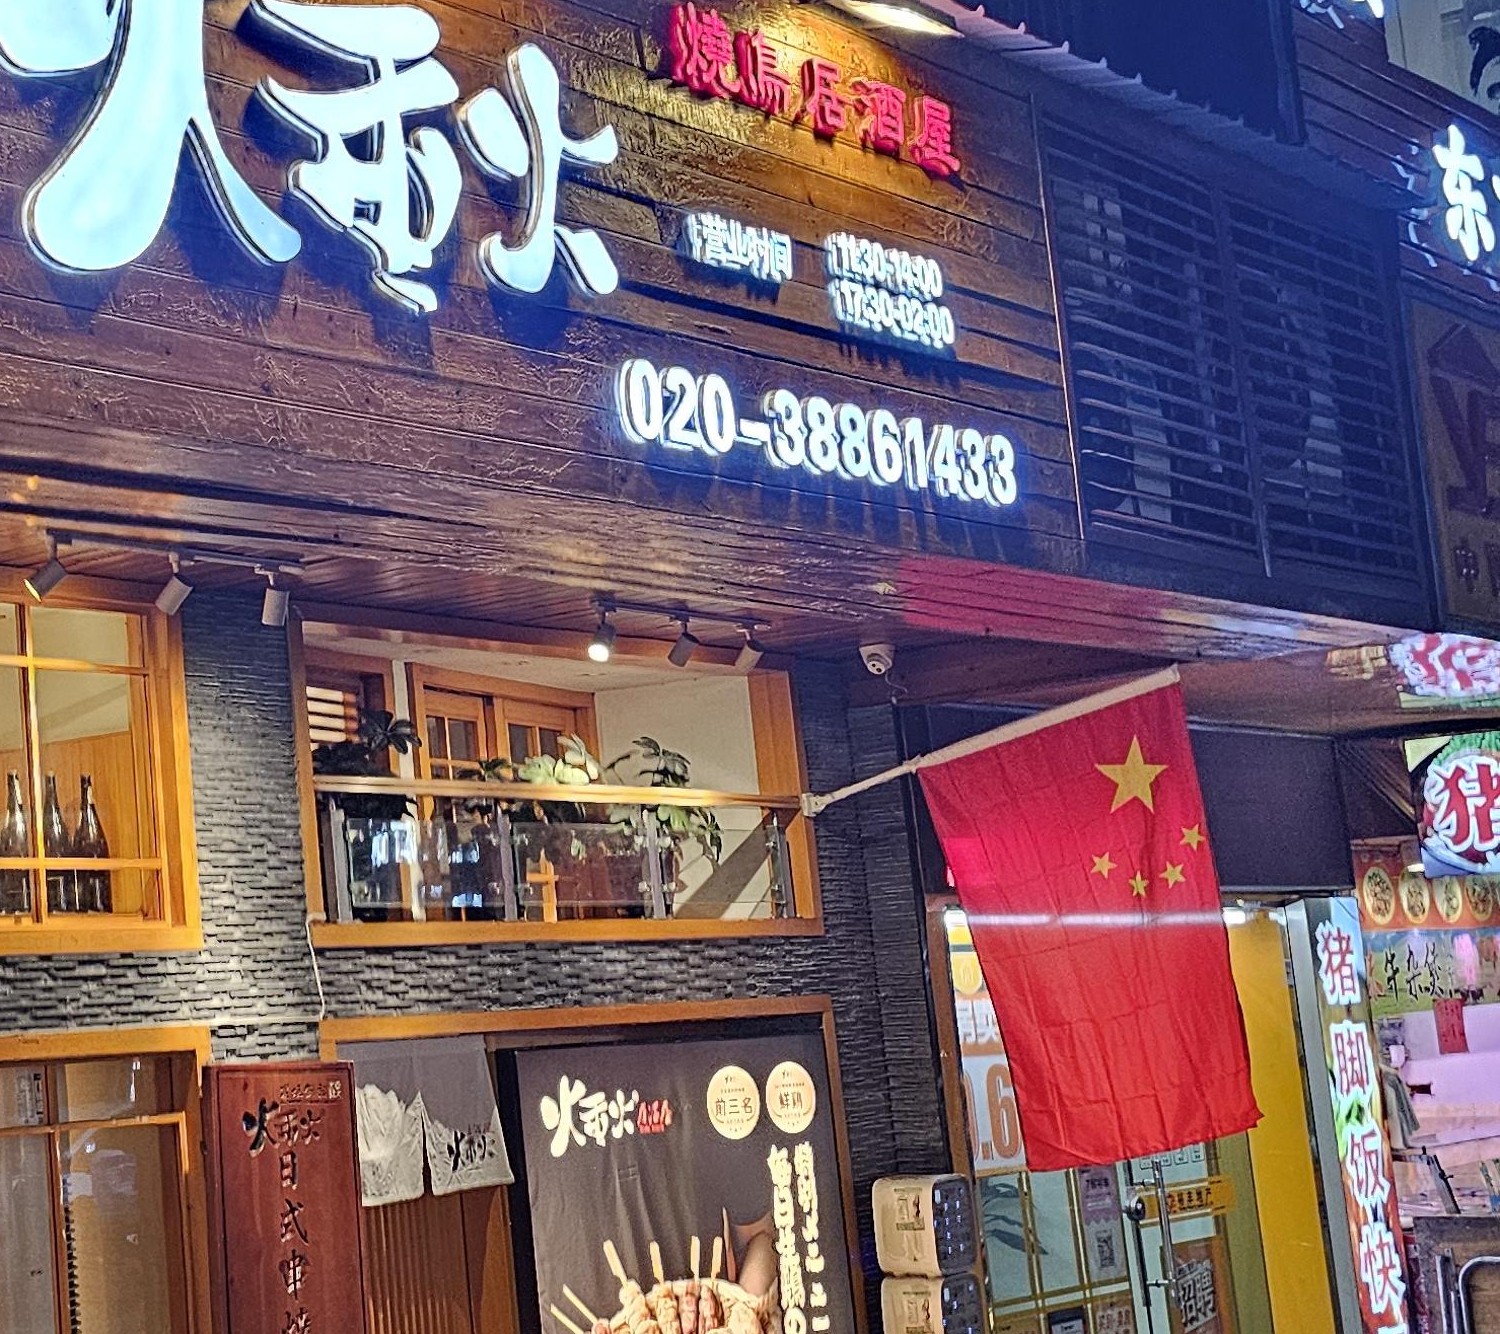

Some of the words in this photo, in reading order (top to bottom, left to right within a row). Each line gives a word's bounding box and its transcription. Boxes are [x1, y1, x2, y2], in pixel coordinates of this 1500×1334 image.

[686, 213, 792, 283] 营业时间
[827, 232, 943, 301] 11:30-14:00
[832, 279, 955, 348] 17:30-02:00
[618, 358, 1017, 506] 020-38861433
[1179, 1267, 1217, 1328] 招聘
